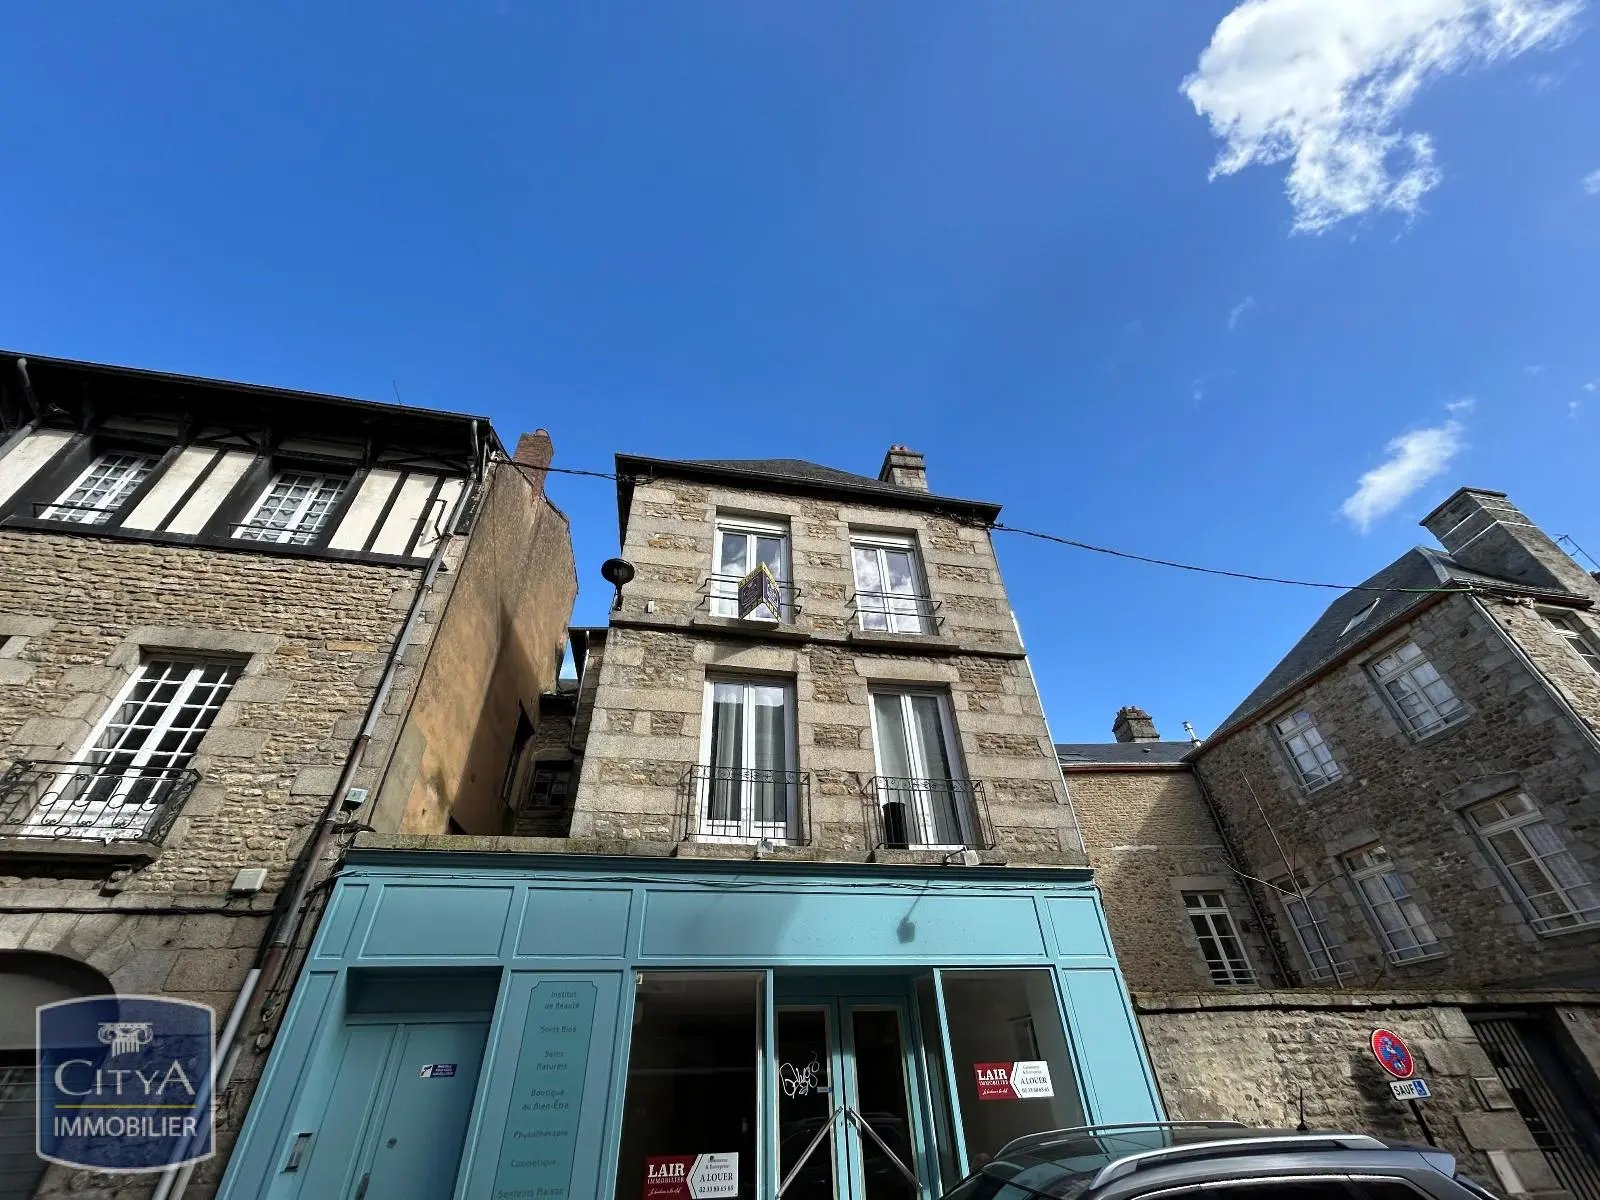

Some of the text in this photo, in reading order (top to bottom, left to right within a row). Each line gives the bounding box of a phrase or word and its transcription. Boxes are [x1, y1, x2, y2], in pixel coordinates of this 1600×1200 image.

[977, 1068, 1008, 1081] LAIR
[531, 1089, 565, 1098] Boutique
[1394, 1084, 1415, 1095] SAUF
[648, 1163, 686, 1177] LAIR
[706, 1172, 733, 1181] LOUER
